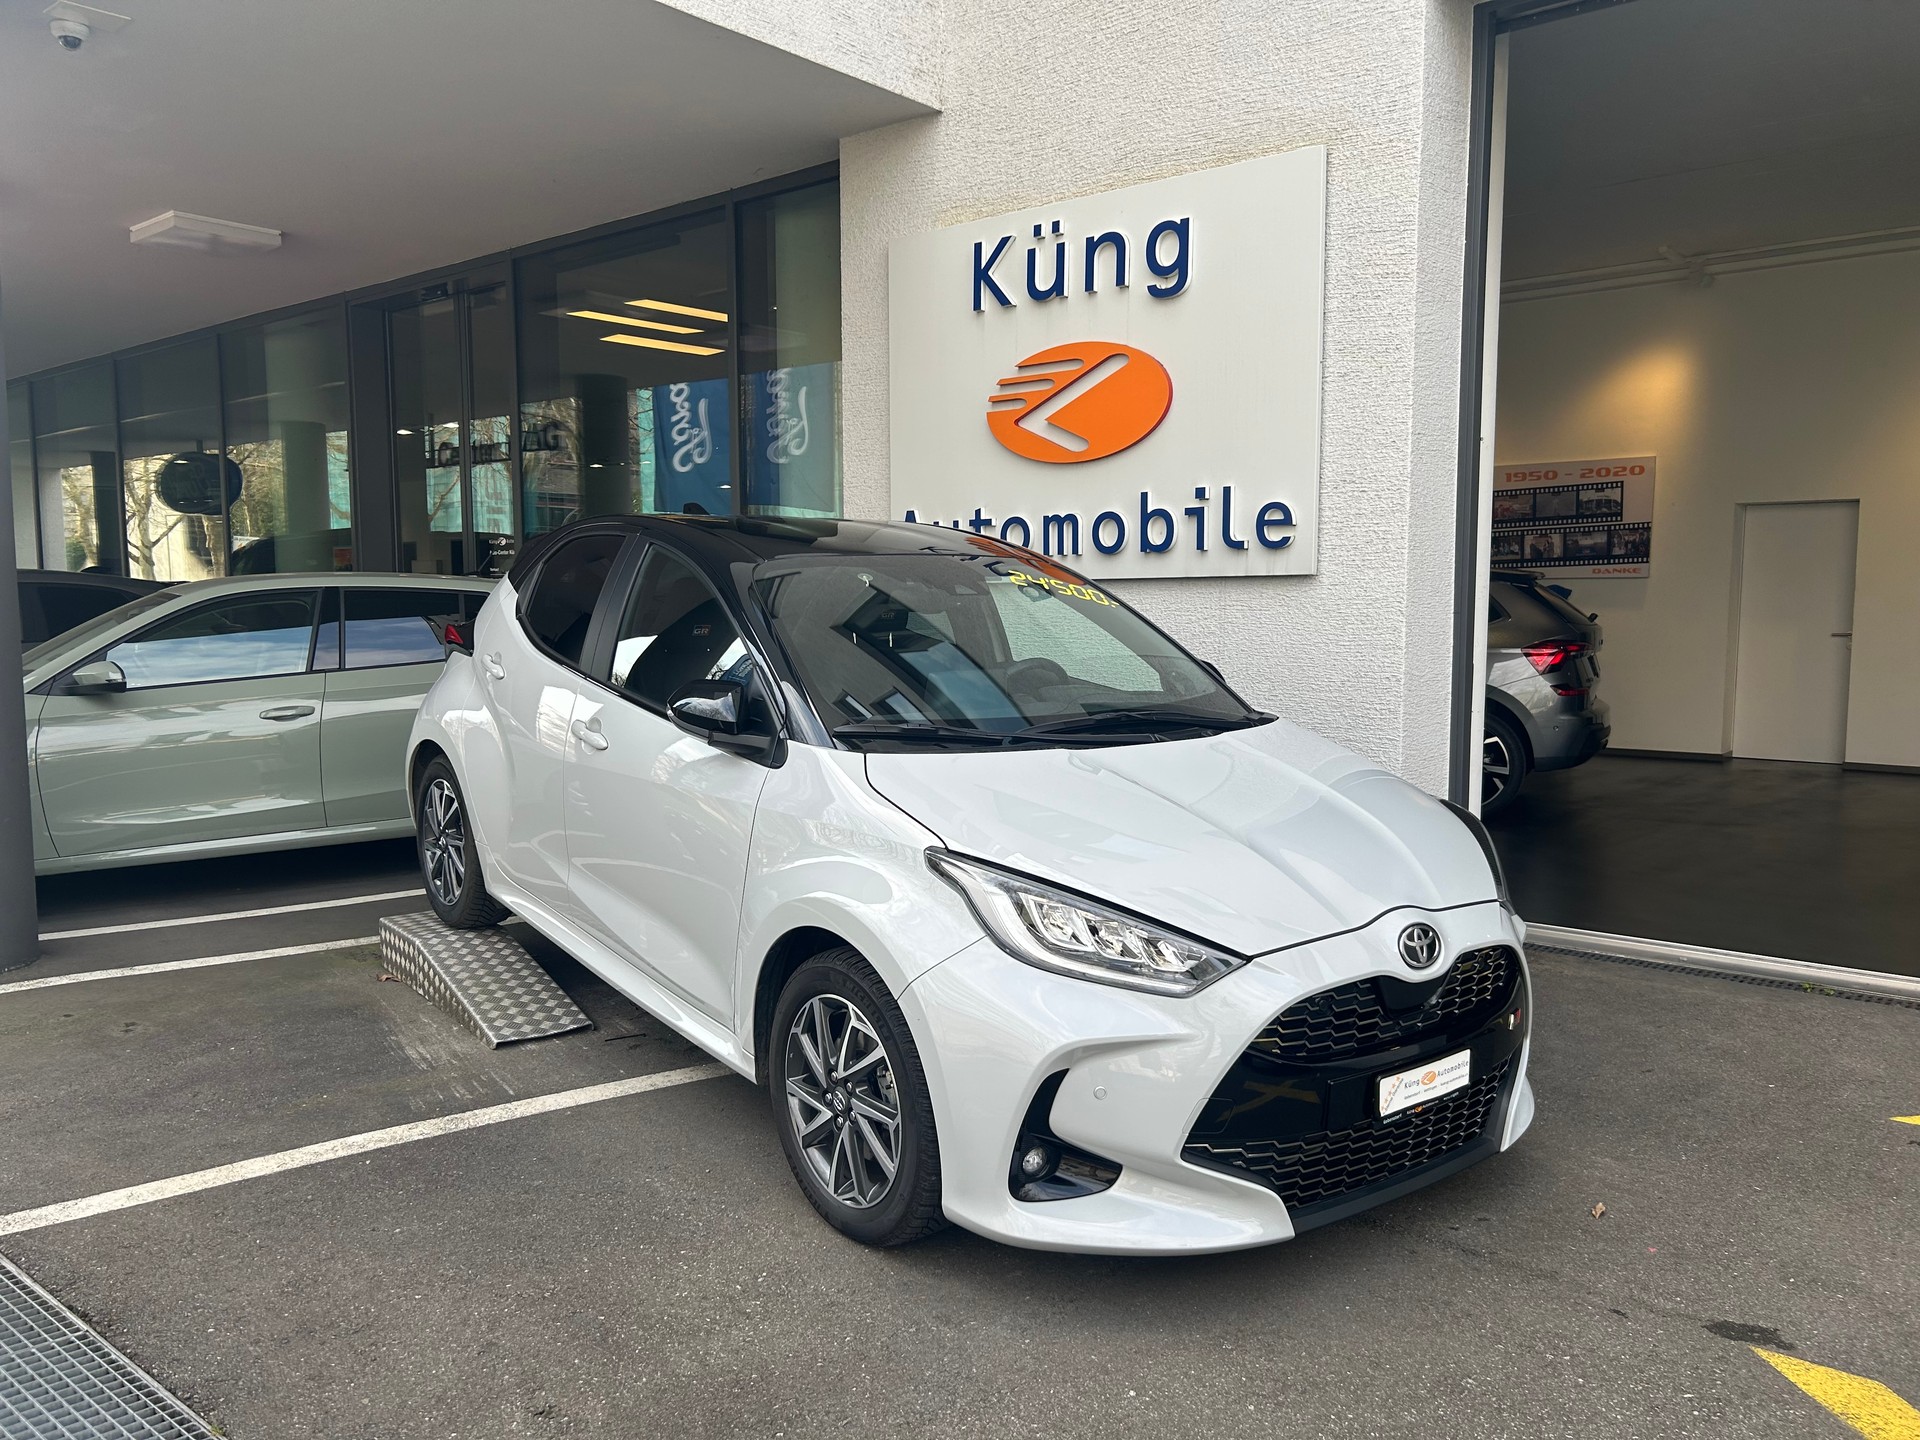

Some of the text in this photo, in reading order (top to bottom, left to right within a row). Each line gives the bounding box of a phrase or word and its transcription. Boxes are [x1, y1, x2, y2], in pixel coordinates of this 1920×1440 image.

[972, 217, 1193, 312] Küng
[1504, 470, 1558, 483] 1950
[1580, 464, 1645, 479] 2020
[904, 486, 1297, 556] tomobile
[1404, 1060, 1469, 1089] Küng Automobile
